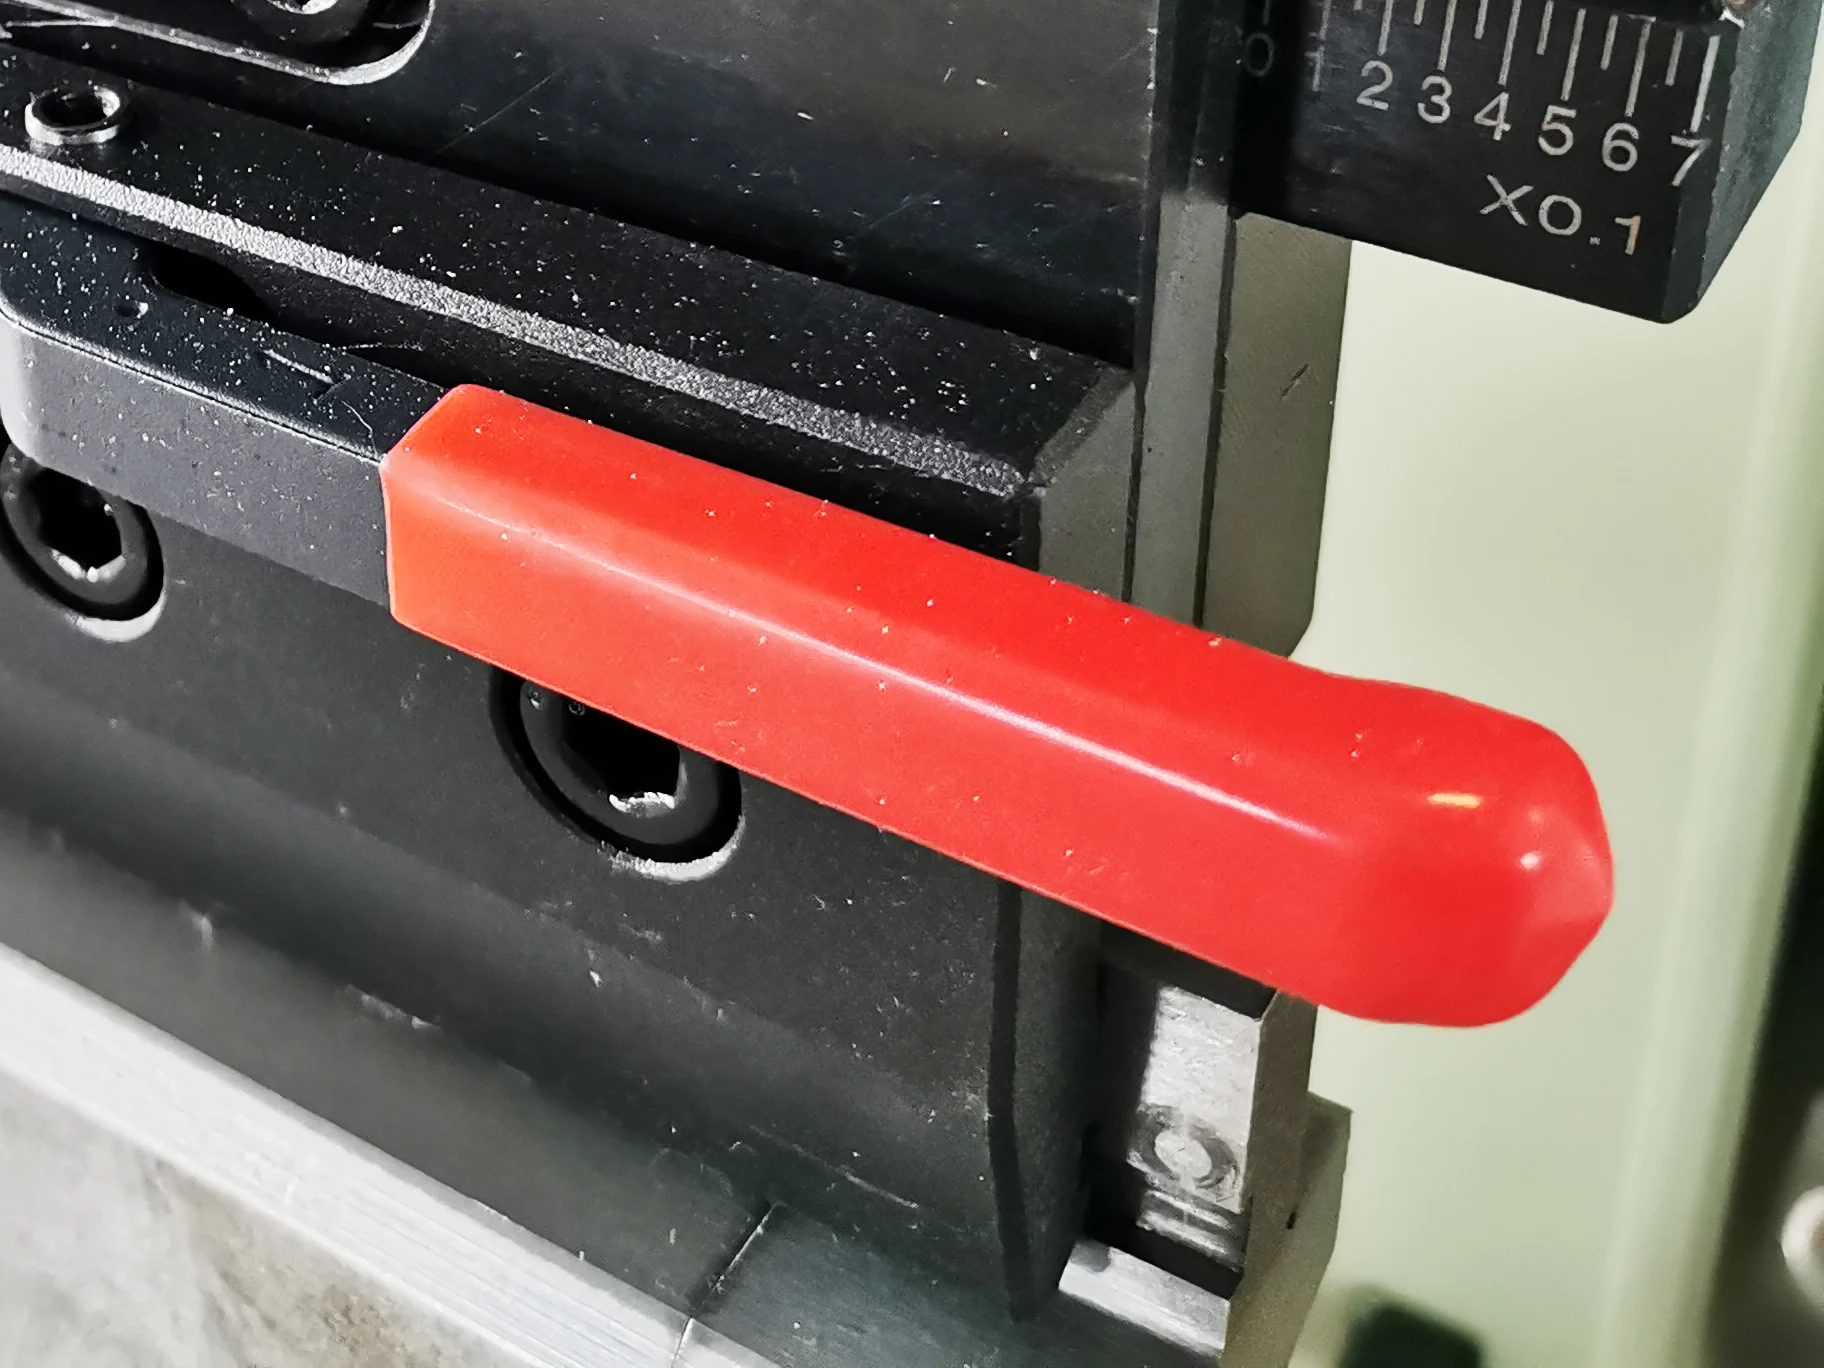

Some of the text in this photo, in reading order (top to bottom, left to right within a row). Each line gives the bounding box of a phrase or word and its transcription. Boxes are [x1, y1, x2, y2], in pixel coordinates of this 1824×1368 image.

[1357, 59, 1395, 111] 2
[1417, 75, 1453, 125] 3
[1473, 91, 1513, 142] 4
[1538, 105, 1577, 157] 5
[1602, 122, 1640, 173] 6
[1670, 135, 1712, 188] 7
